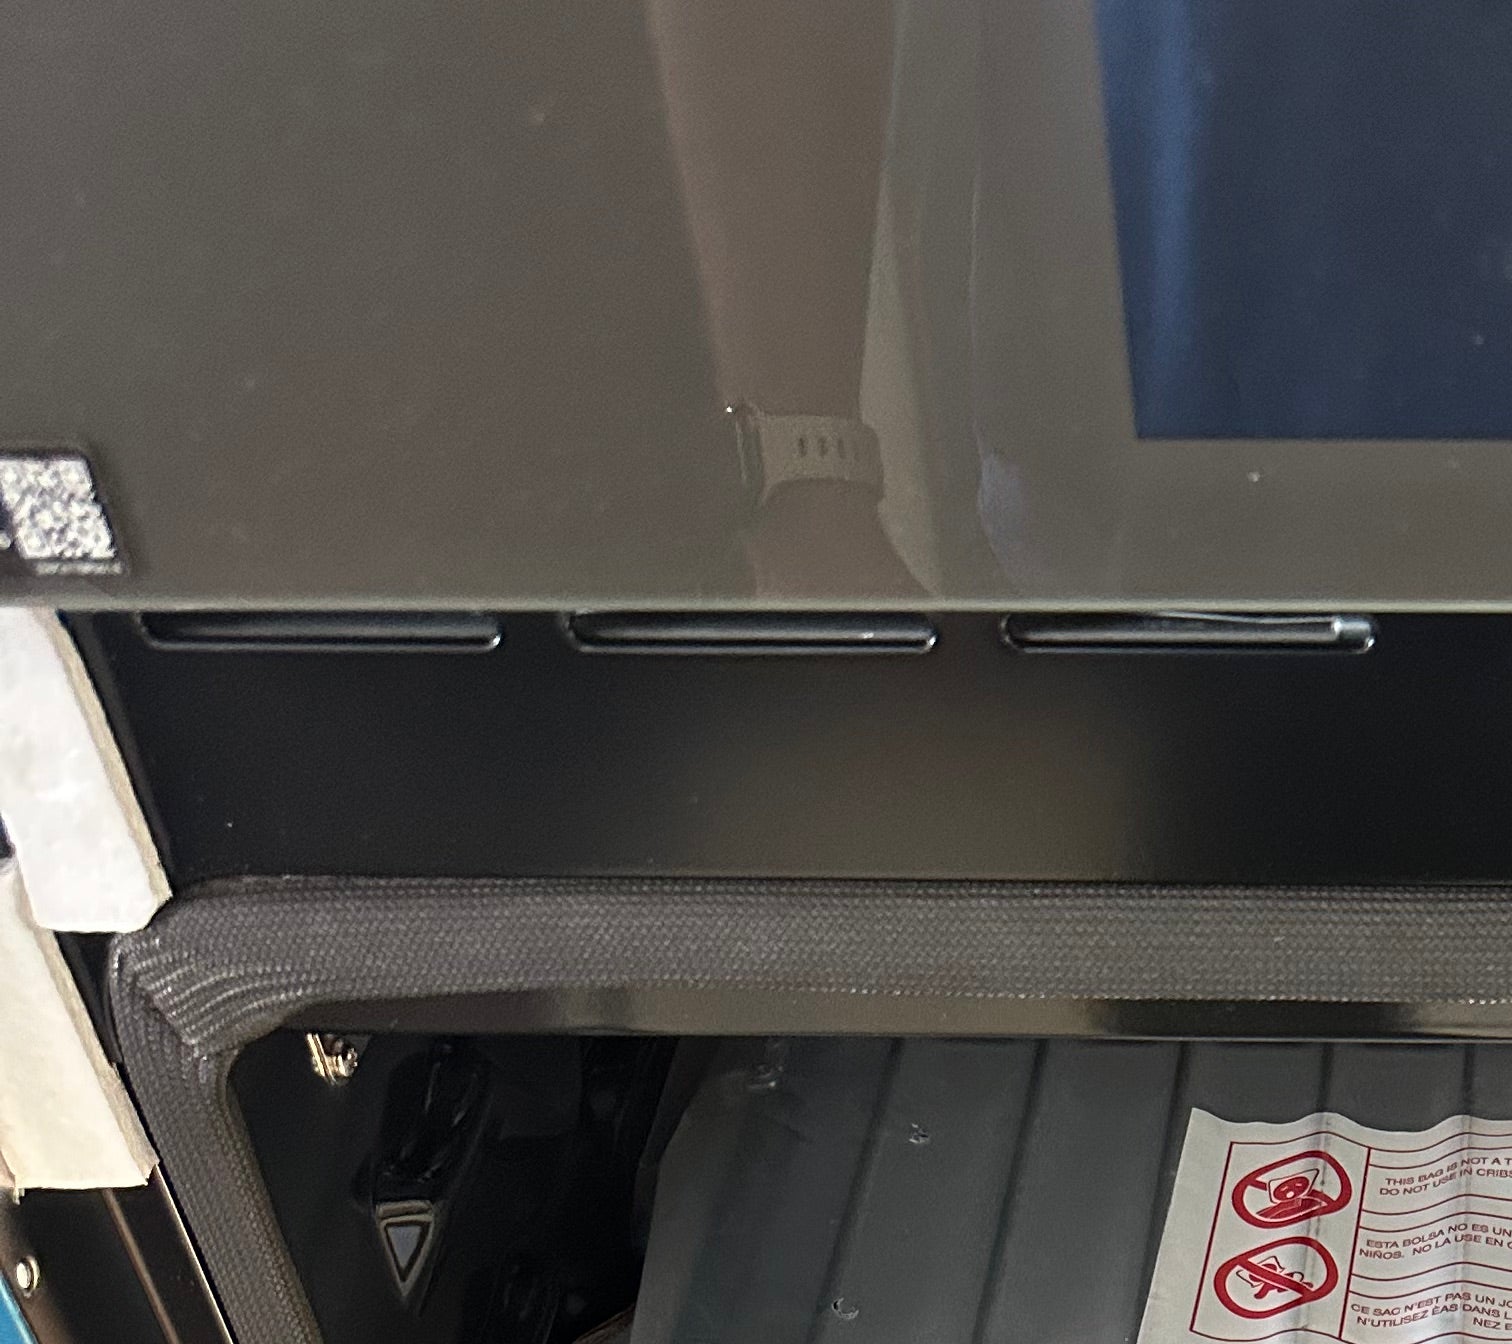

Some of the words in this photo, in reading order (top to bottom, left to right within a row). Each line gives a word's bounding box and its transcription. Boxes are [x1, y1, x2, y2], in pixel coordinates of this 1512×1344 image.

[1384, 1176, 1414, 1185] THIS
[1417, 1168, 1443, 1182] BAG
[1446, 1161, 1457, 1172] IS
[1460, 1156, 1488, 1166] NOT
[1490, 1156, 1501, 1165] A
